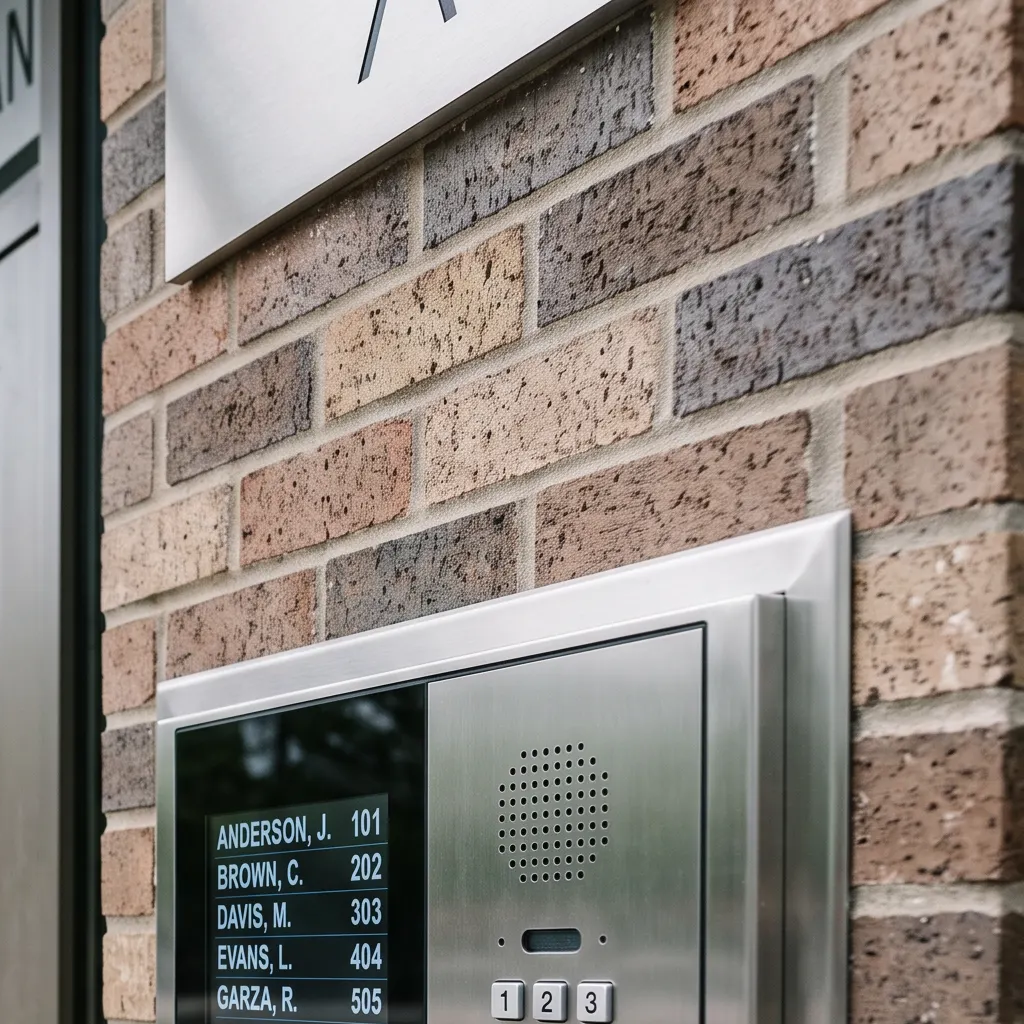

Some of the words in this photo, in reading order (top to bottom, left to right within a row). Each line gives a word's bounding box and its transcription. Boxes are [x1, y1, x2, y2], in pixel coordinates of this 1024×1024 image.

[217, 815, 312, 850] ANDERSON,
[317, 813, 332, 841] J.
[351, 807, 381, 838] 101
[217, 861, 282, 892] BROWN,
[287, 859, 303, 886] C.
[350, 853, 382, 881] 202
[217, 903, 268, 933] DAVIS,
[273, 902, 291, 928] M.
[350, 898, 382, 925] 303
[217, 944, 274, 974] EVANS,
[278, 944, 292, 970] L.
[350, 943, 382, 970] 404
[217, 985, 276, 1016] GARZA,
[281, 986, 297, 1013] R.
[350, 988, 382, 1015] 505
[500, 990, 508, 1012] 1
[541, 991, 553, 1013] 2
[585, 991, 597, 1014] 3
